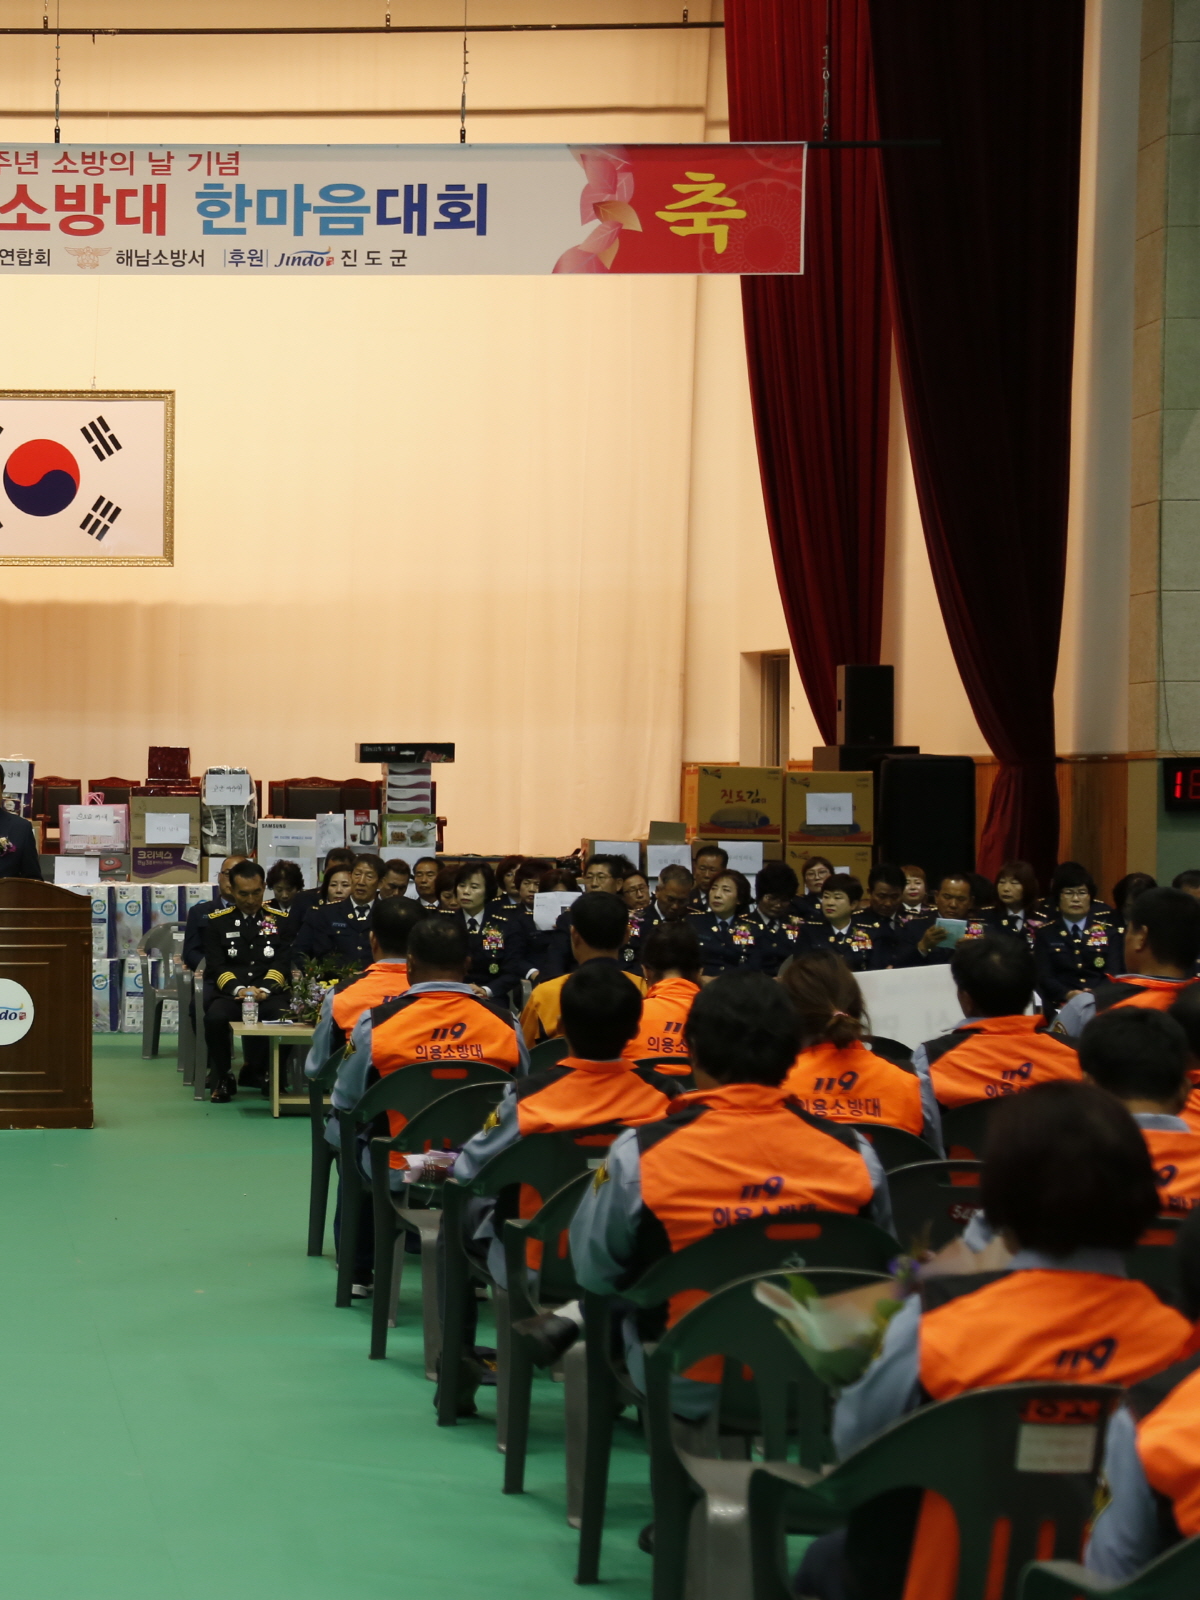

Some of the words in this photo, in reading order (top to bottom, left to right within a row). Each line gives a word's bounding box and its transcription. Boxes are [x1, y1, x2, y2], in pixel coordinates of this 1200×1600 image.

[51, 149, 135, 177] 소방의
[148, 149, 174, 177] 날
[187, 149, 241, 177] 기념
[194, 182, 488, 238] 한마음대회
[655, 171, 747, 254] 축
[116, 247, 205, 269] 해남소방서
[228, 247, 265, 269] 후원
[274, 250, 326, 268] Jindo
[720, 789, 761, 804] 진도김
[137, 850, 174, 860] 크리넥스
[430, 1022, 467, 1042] 119
[663, 1021, 683, 1034] 11
[415, 1043, 484, 1060] 의용소방대
[647, 1036, 689, 1054] 의용소
[813, 1070, 860, 1094] 119
[1001, 1062, 1034, 1081] 119
[740, 1175, 785, 1202] 119
[1055, 1337, 1119, 1374] 119
